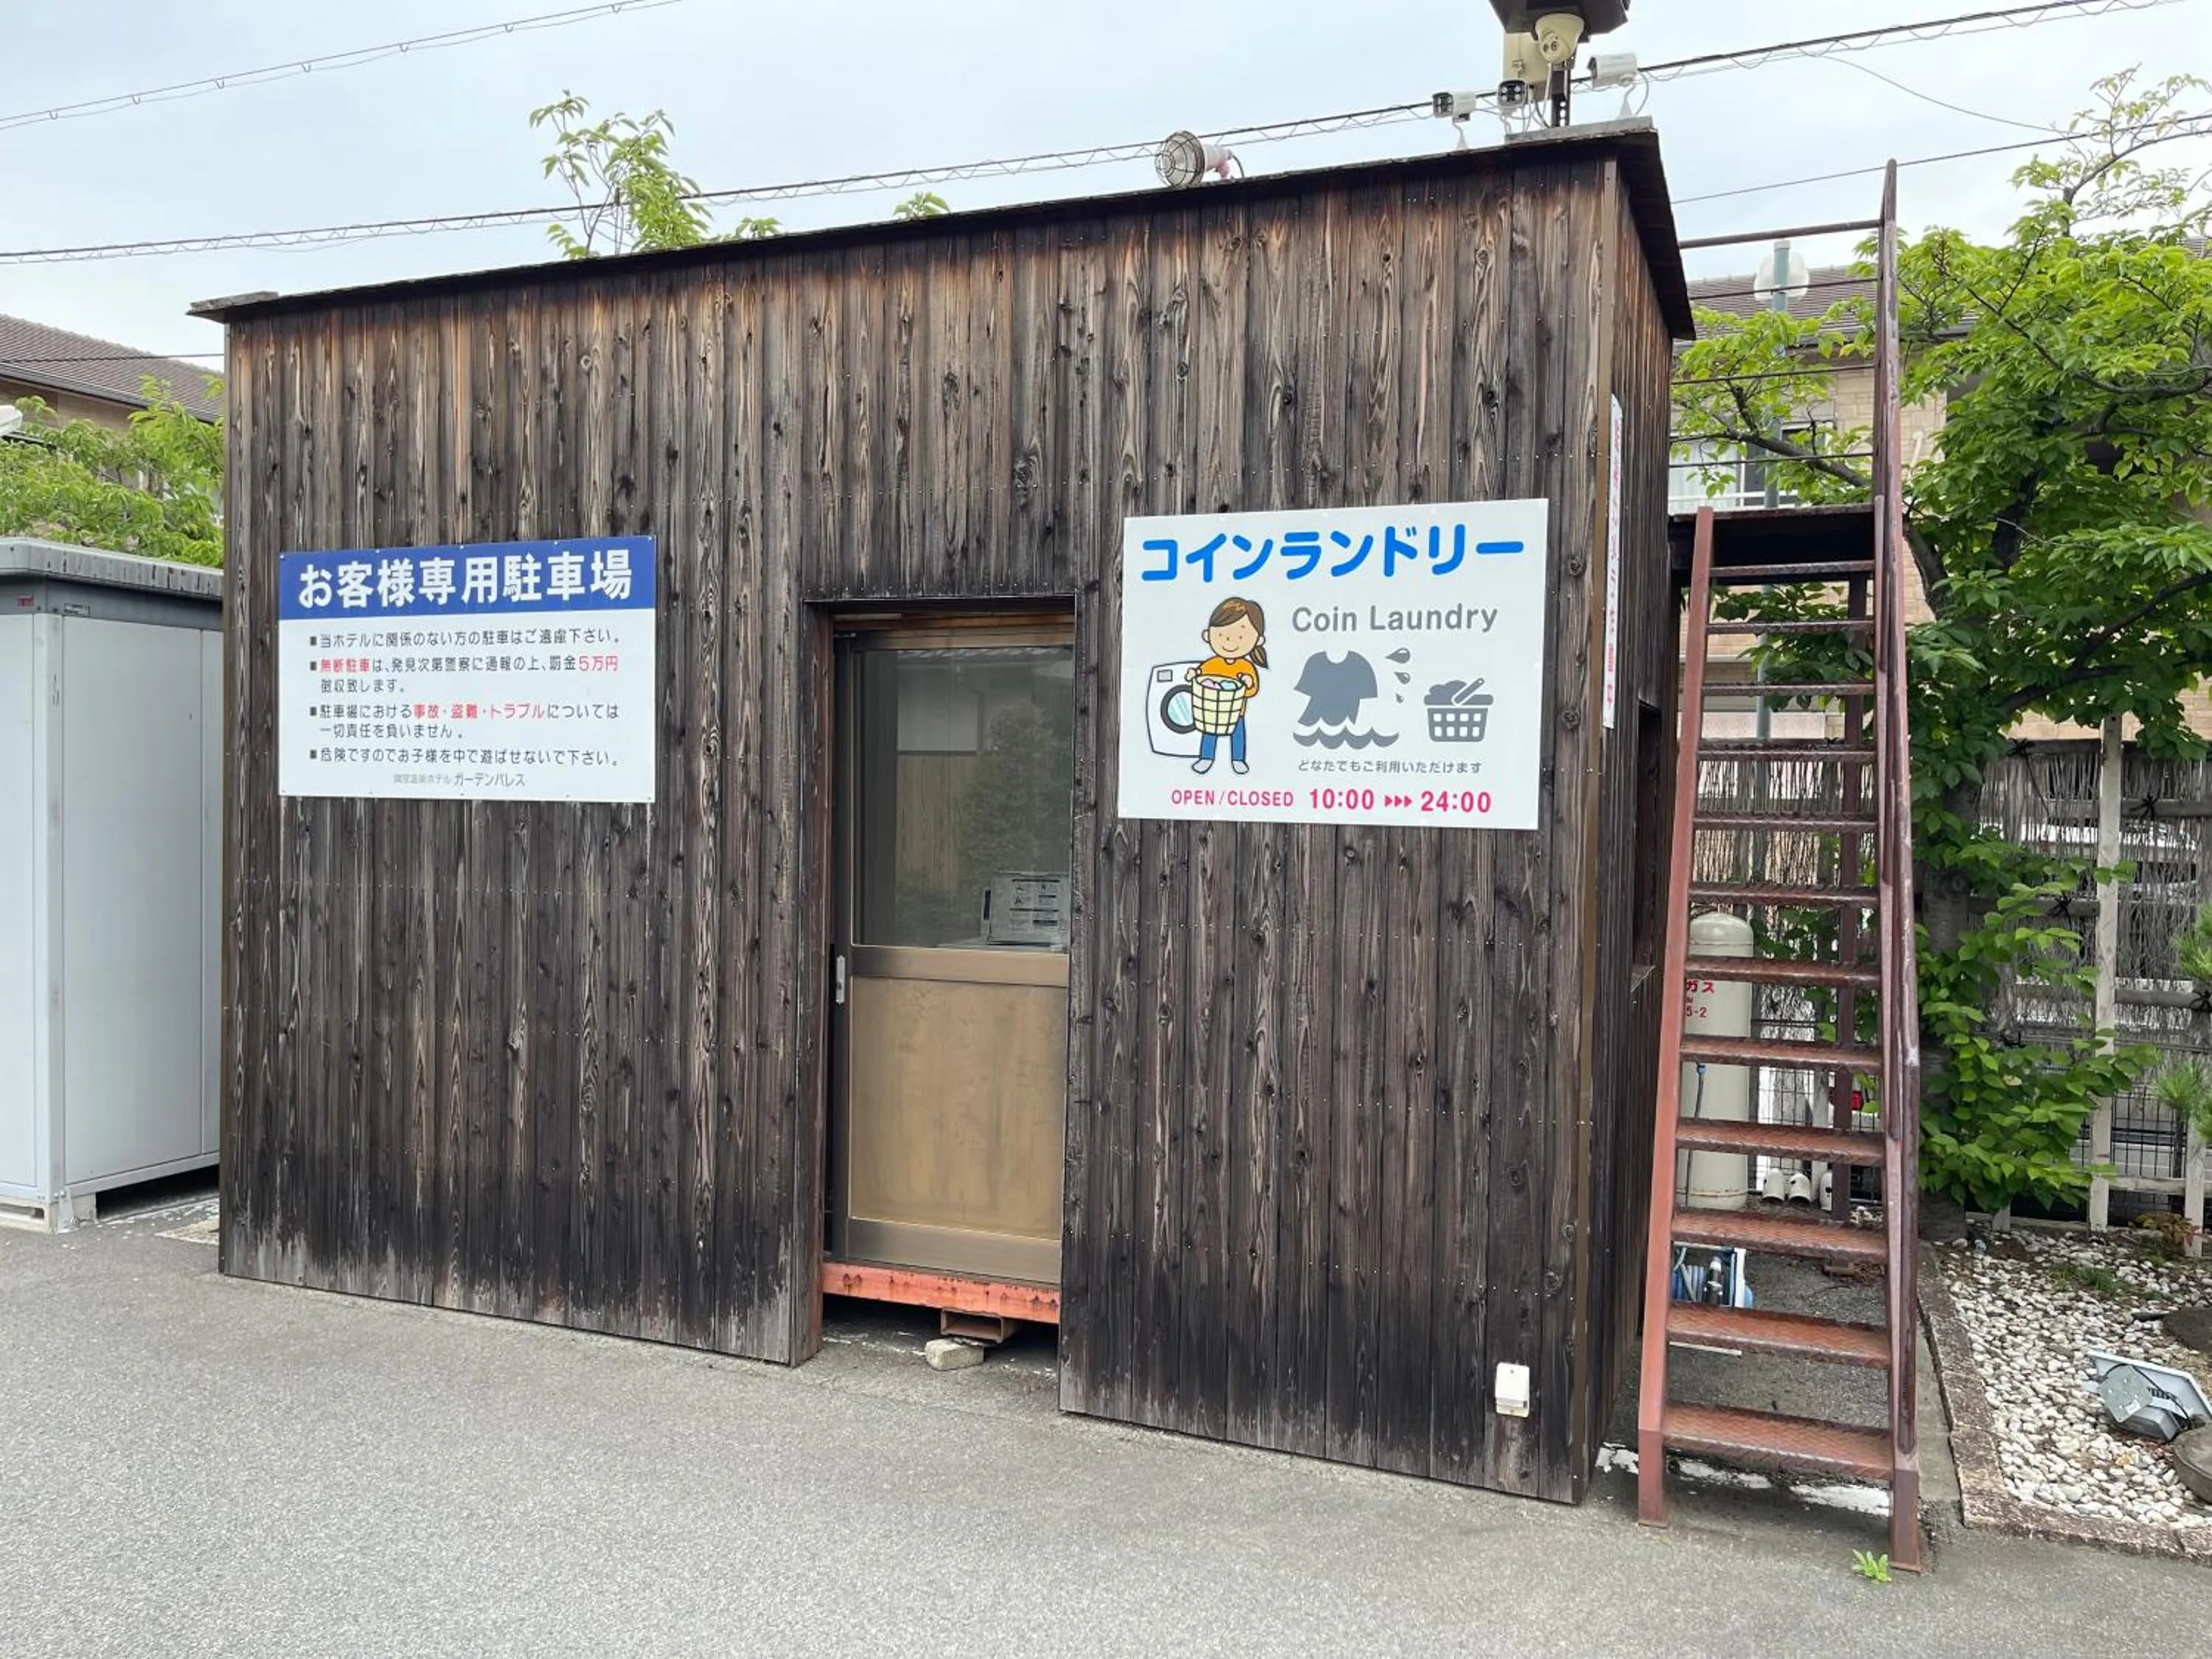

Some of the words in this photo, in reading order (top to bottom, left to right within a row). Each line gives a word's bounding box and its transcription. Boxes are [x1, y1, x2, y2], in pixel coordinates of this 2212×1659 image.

[1141, 524, 1524, 582] コインランドリー
[299, 549, 633, 608] お客様専用駐車場
[1292, 606, 1357, 632] Coin
[1369, 602, 1498, 633] Laundry
[1298, 759, 1483, 773] どなたでもご利用いただけます
[1310, 788, 1374, 810] 10:00
[1421, 790, 1492, 813] 24:00
